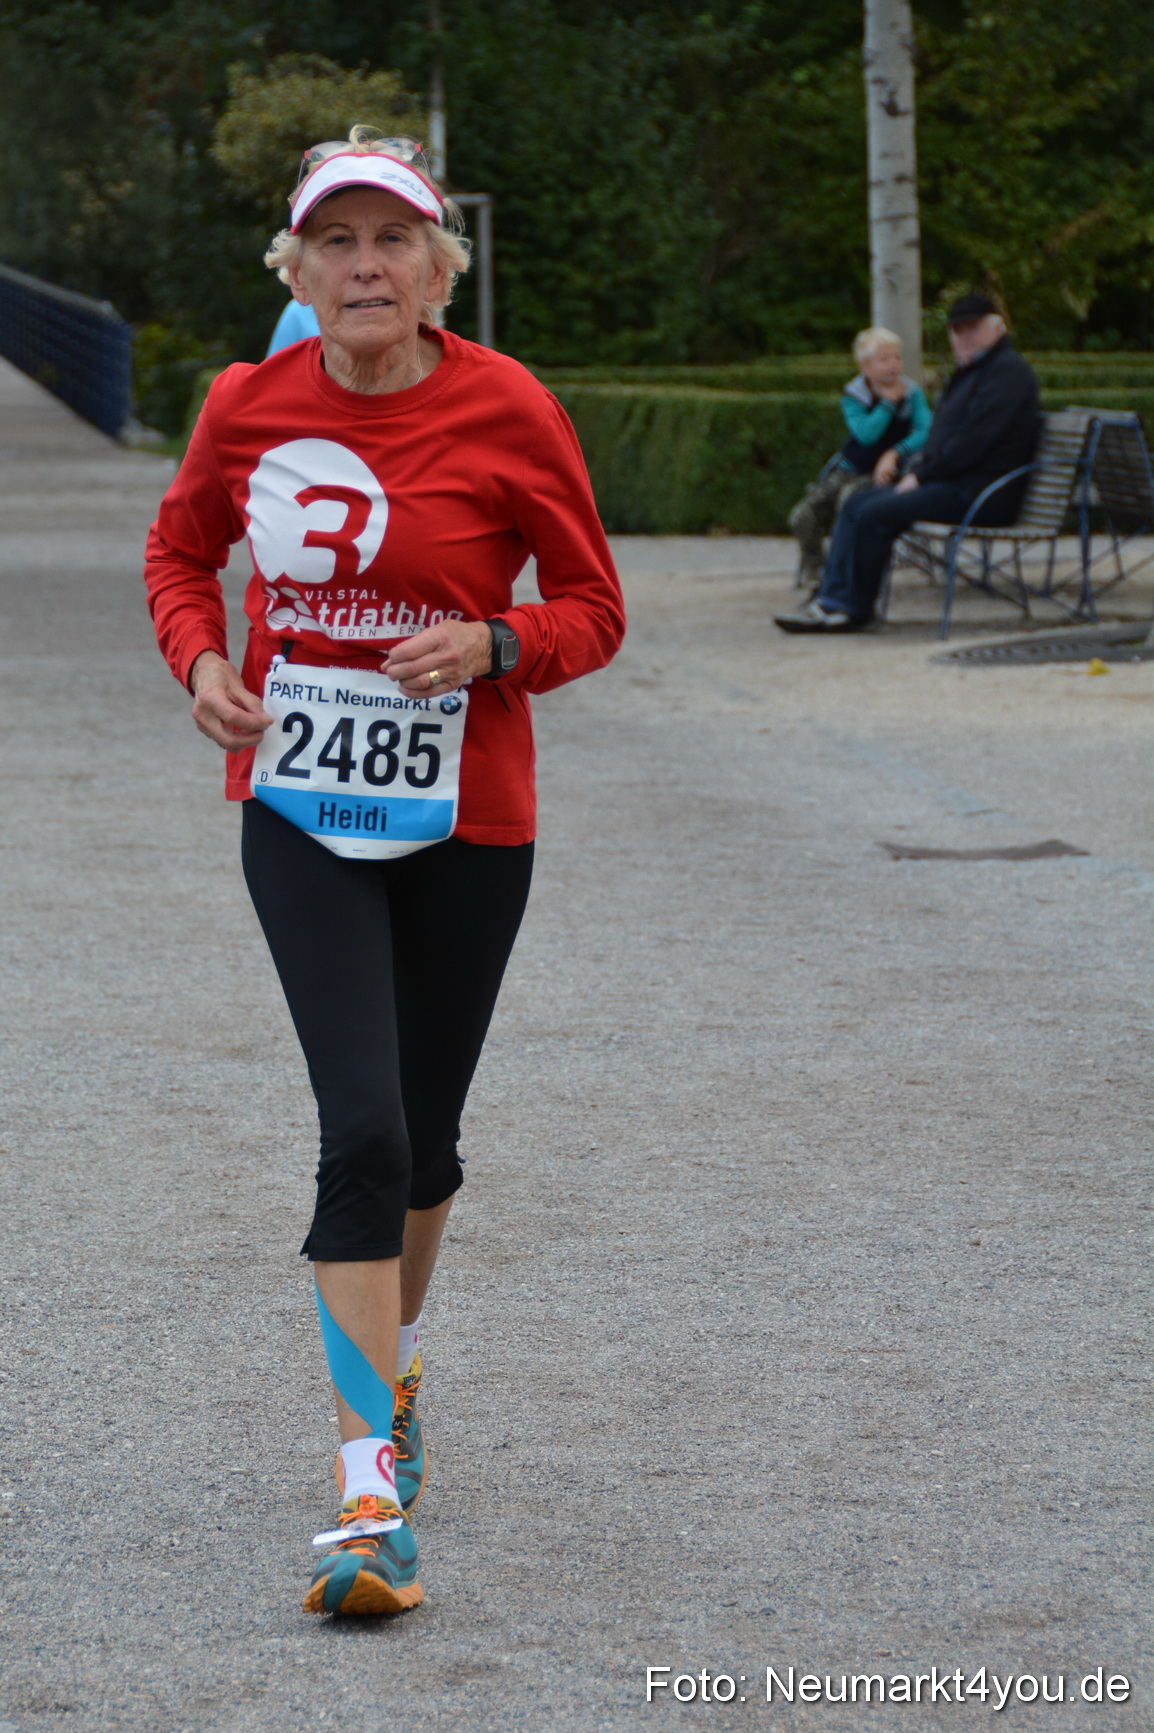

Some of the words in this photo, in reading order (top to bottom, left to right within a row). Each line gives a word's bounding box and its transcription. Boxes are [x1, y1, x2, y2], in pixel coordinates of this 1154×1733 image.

[379, 172, 422, 195] 2XU
[305, 588, 378, 602] VILSTAL
[326, 628, 377, 638] IEDEN
[270, 681, 329, 704] PARTL
[335, 688, 431, 711] Neumarkt
[275, 711, 442, 789] 2485
[260, 771, 268, 783] D
[318, 801, 387, 832] Heidi
